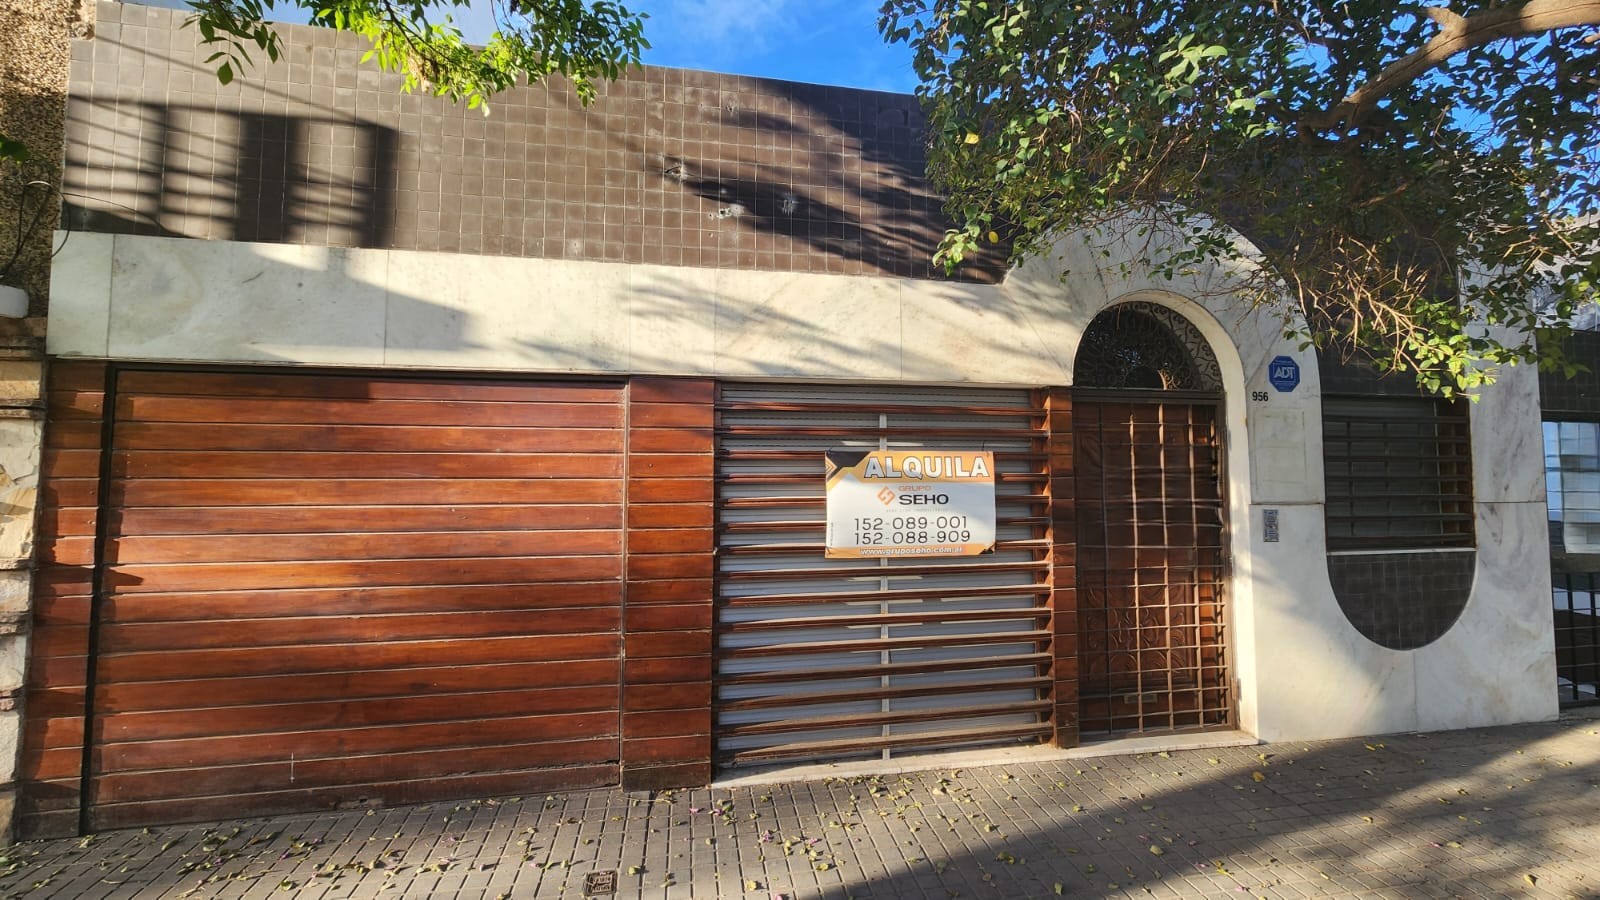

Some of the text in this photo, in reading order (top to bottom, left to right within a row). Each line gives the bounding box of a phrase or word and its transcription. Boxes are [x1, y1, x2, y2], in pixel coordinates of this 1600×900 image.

[1274, 366, 1295, 379] ADT
[1252, 392, 1269, 401] 956
[864, 456, 989, 480] ALQUILA
[899, 494, 949, 505] SEHO
[854, 516, 967, 531] 152-089-001
[854, 530, 971, 545] 152-088-909
